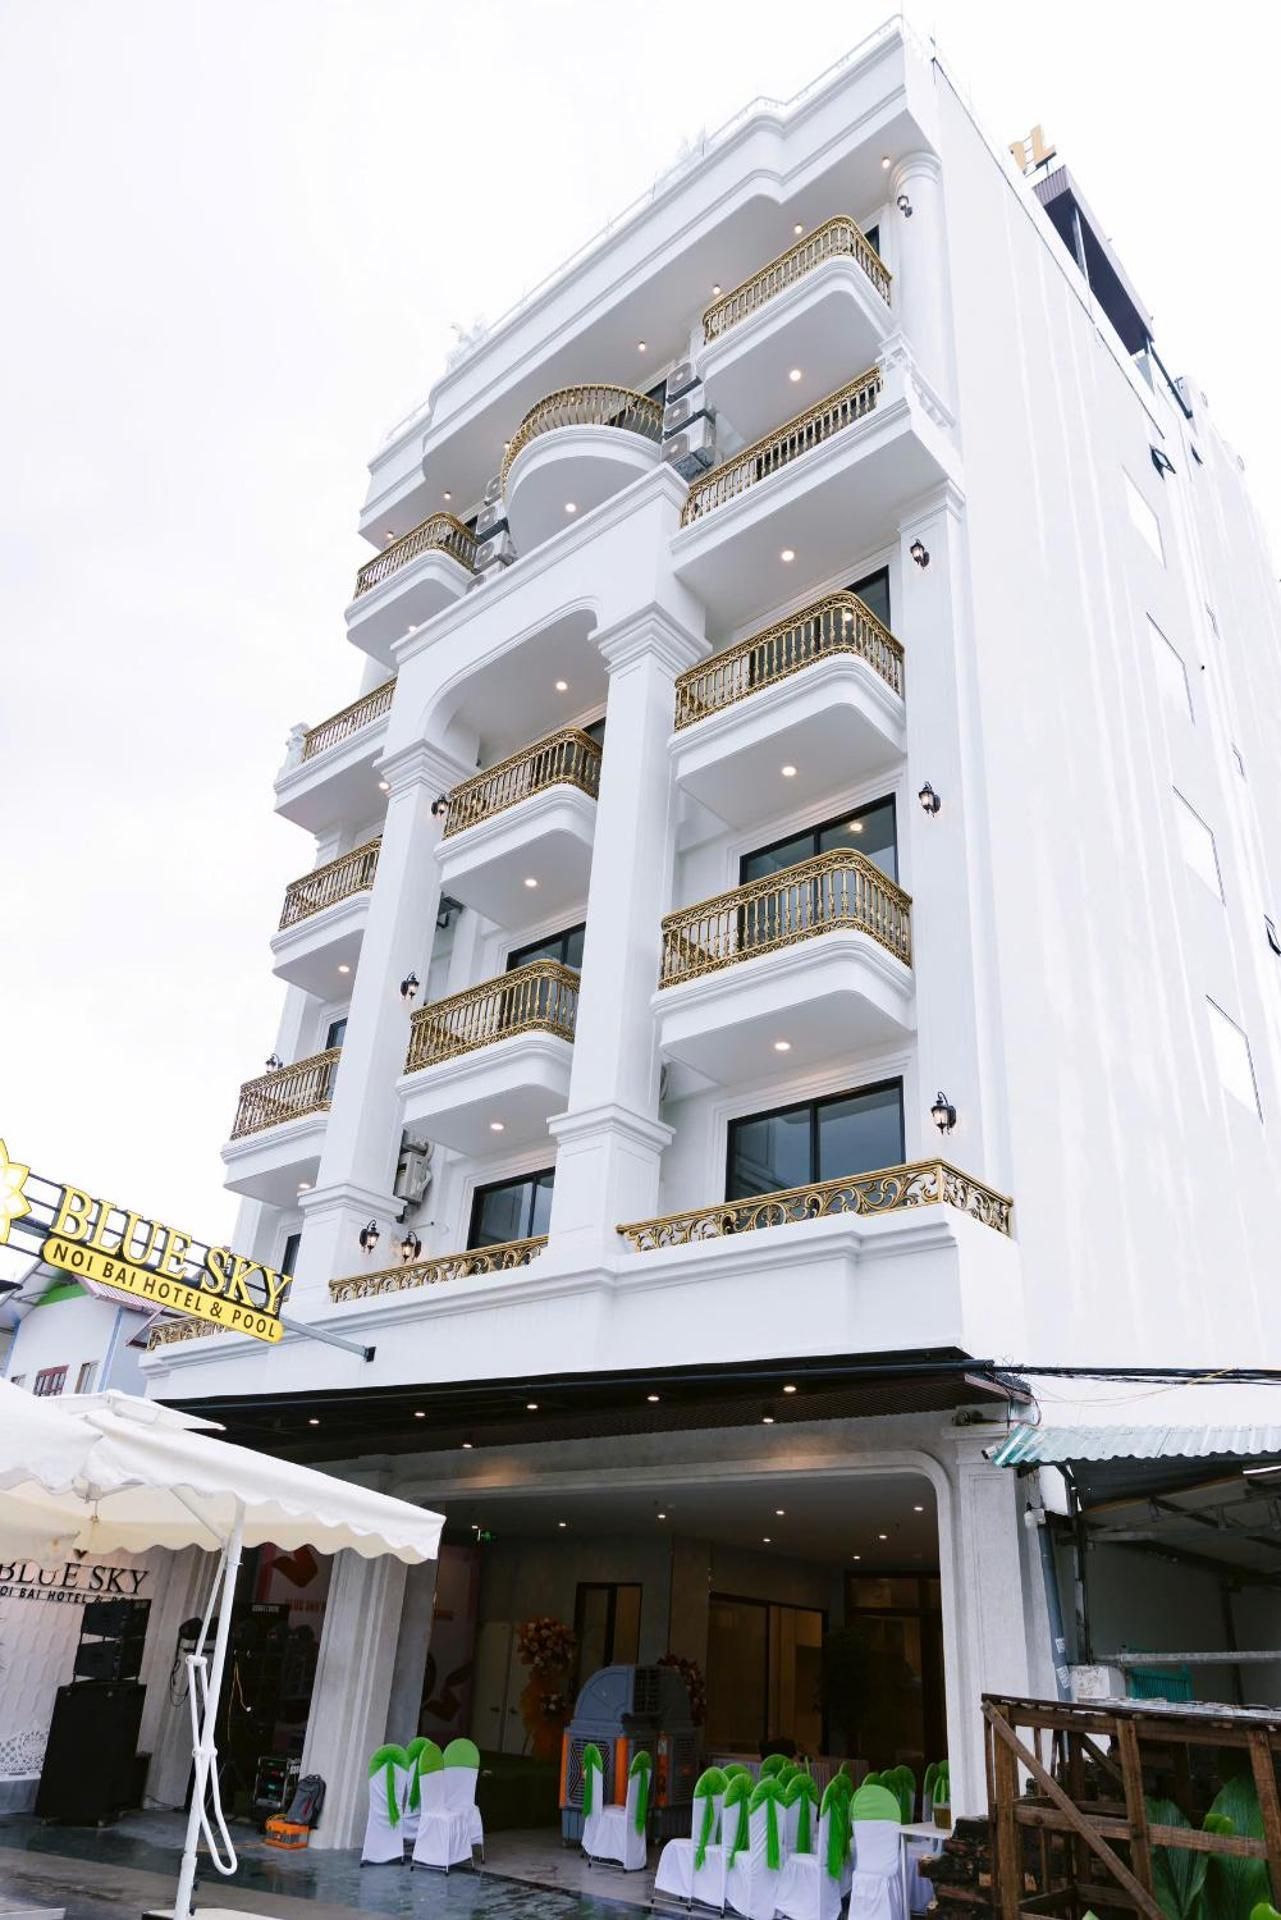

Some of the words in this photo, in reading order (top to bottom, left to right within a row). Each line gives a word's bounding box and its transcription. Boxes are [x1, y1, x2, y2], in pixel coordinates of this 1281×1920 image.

[49, 1184, 192, 1280] BLUE
[200, 1246, 293, 1315] SKY
[53, 1243, 94, 1272] NOI
[102, 1261, 136, 1288] BAI
[143, 1276, 202, 1312] HOTEL
[210, 1302, 222, 1318] &
[231, 1309, 276, 1338] POOL
[0, 1585, 13, 1598] OI
[19, 1587, 41, 1600] BAI
[46, 1590, 87, 1604] HOTEL
[88, 1564, 150, 1595] SKY
